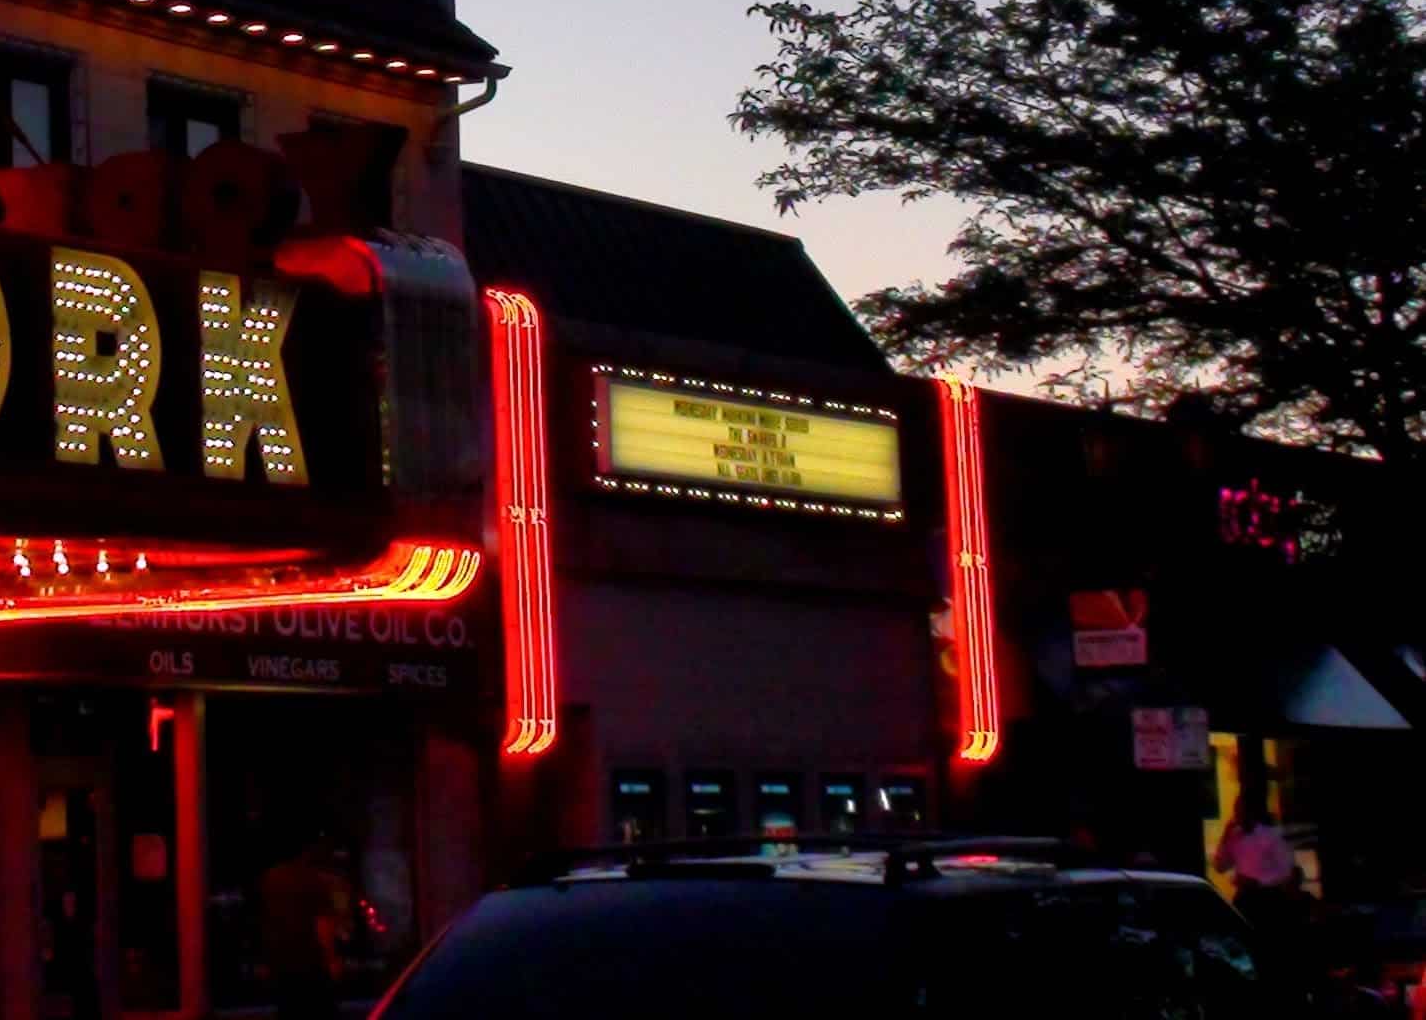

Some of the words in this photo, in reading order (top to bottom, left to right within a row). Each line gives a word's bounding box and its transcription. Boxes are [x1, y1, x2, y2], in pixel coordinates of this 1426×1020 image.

[273, 605, 363, 641] OLIVE
[369, 609, 418, 644] OIL
[149, 650, 194, 675] OILS
[247, 654, 341, 680] VINEGARS
[388, 661, 447, 687] SPICES
